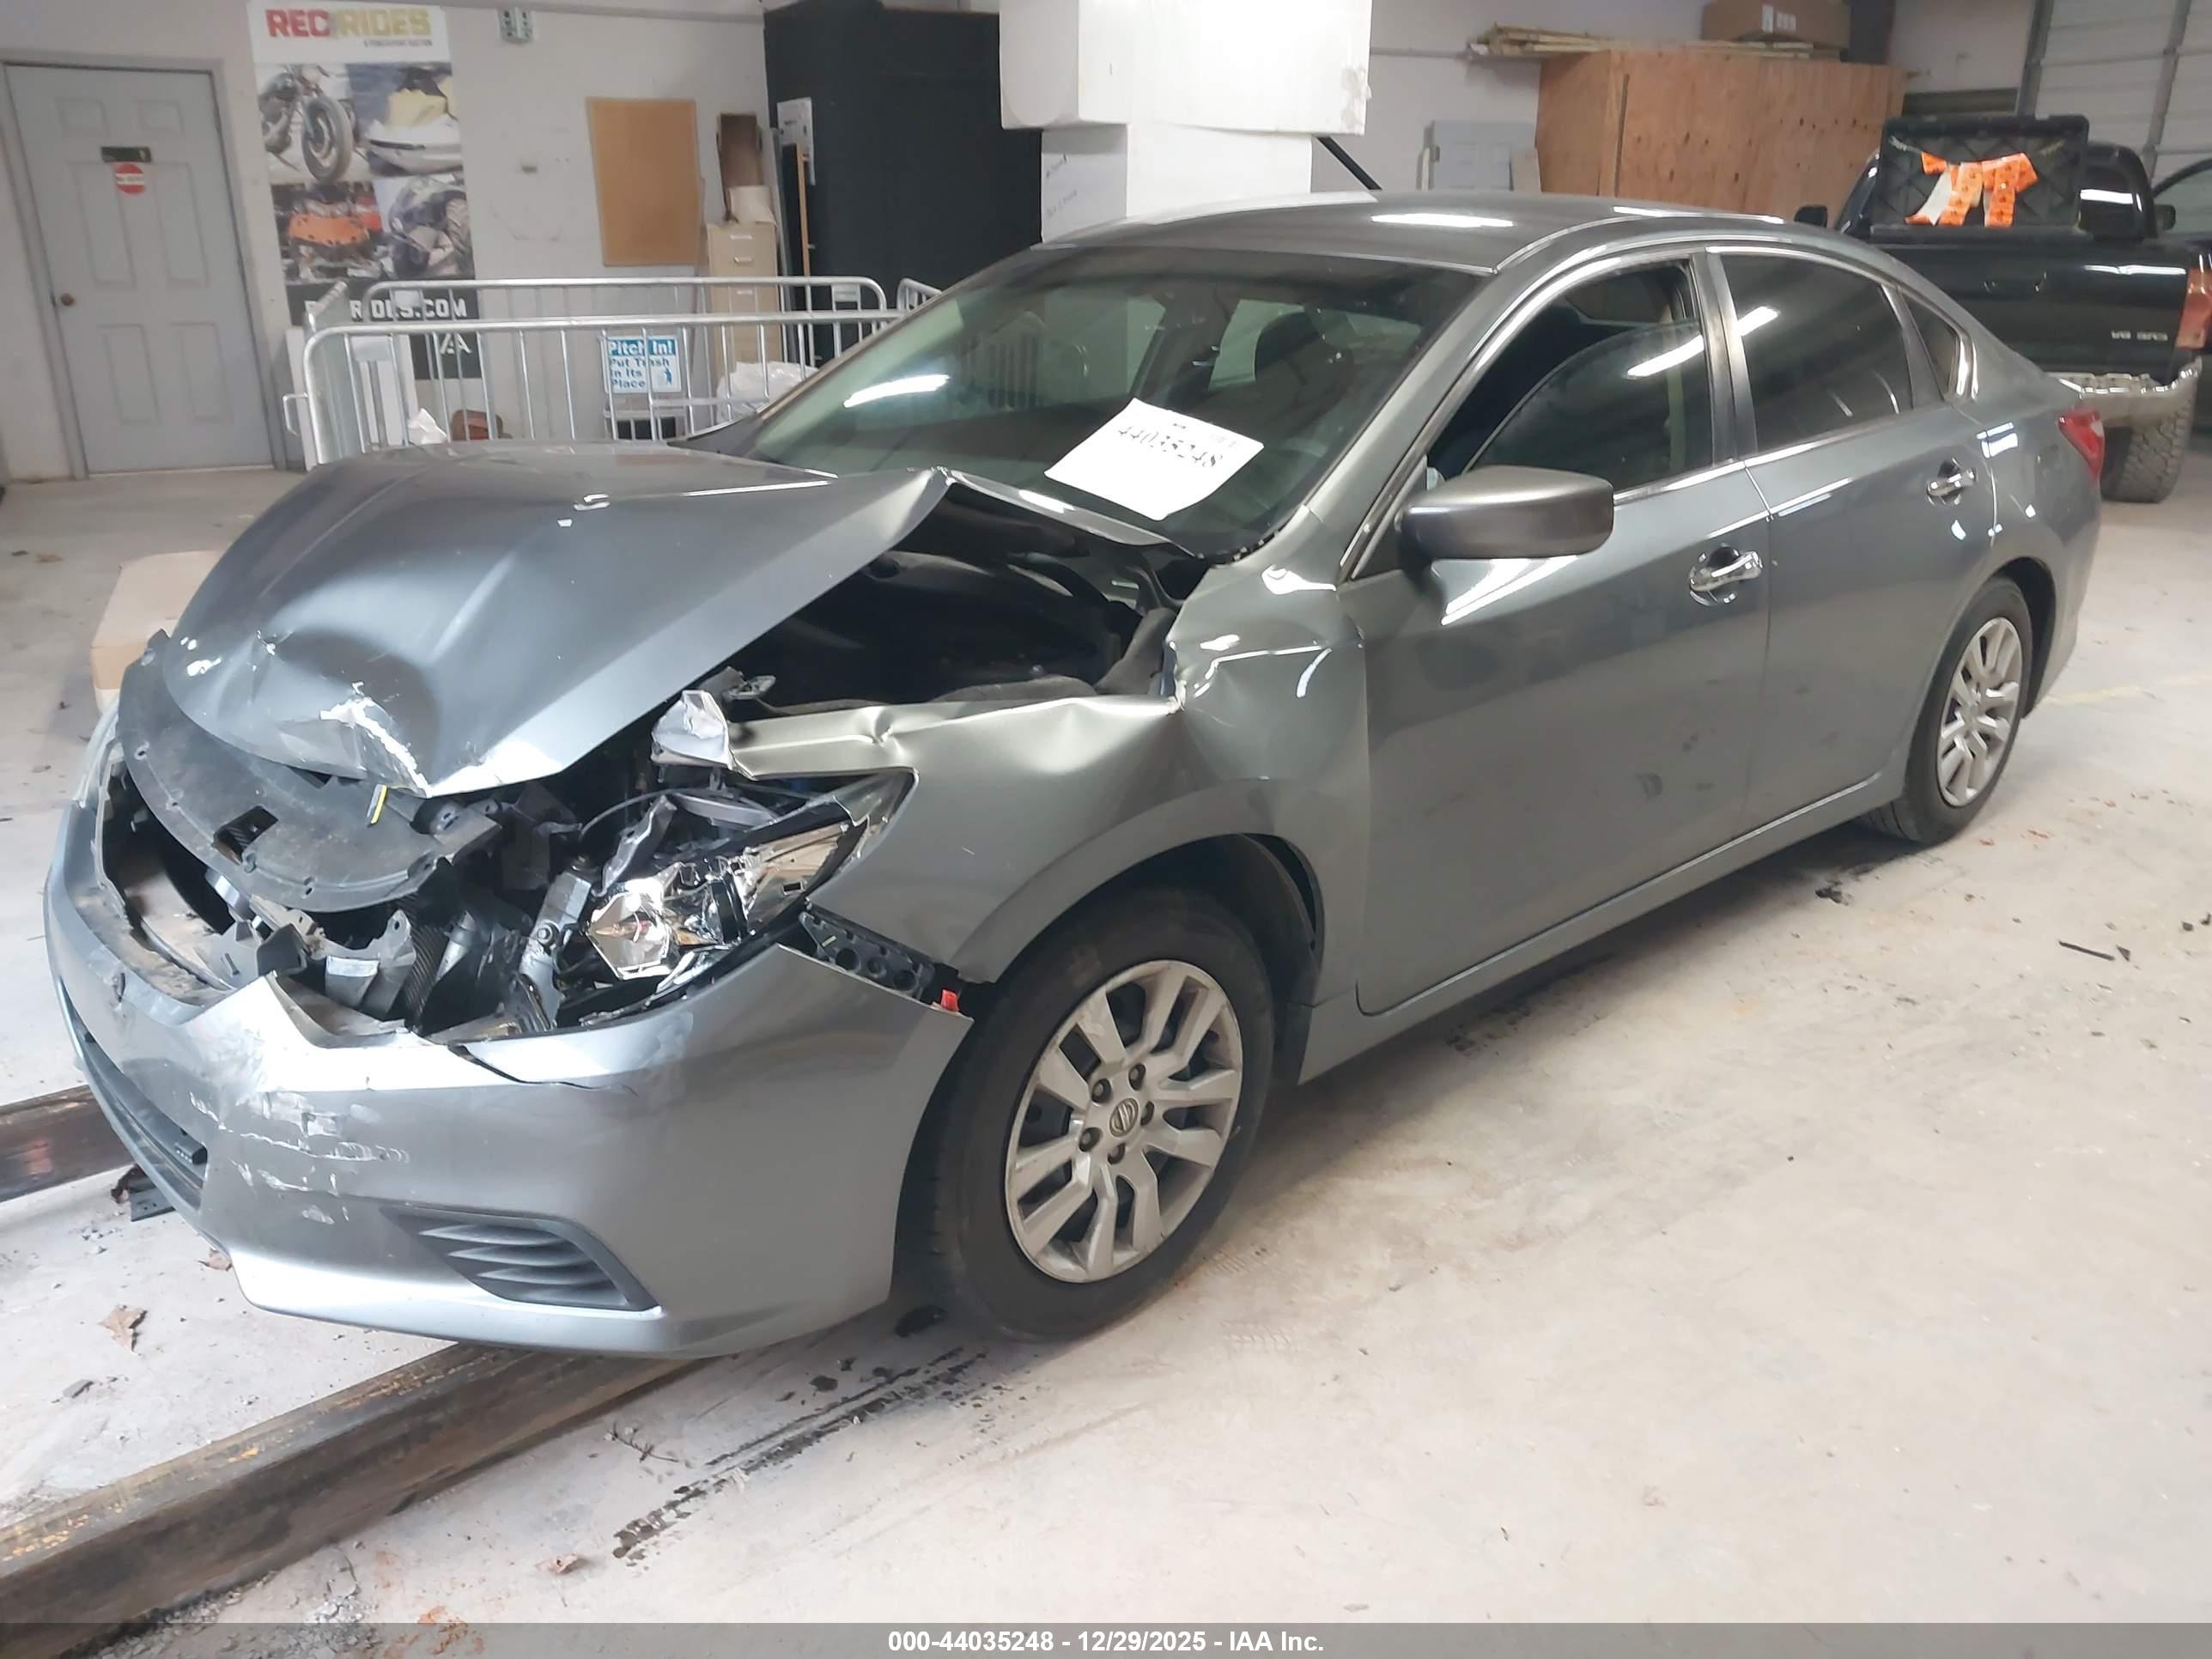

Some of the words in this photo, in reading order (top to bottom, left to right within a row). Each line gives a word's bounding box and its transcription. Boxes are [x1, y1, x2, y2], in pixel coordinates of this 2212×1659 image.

[304, 299, 468, 321] RRDS.COM
[653, 340, 673, 356] In!
[611, 379, 647, 389] Place
